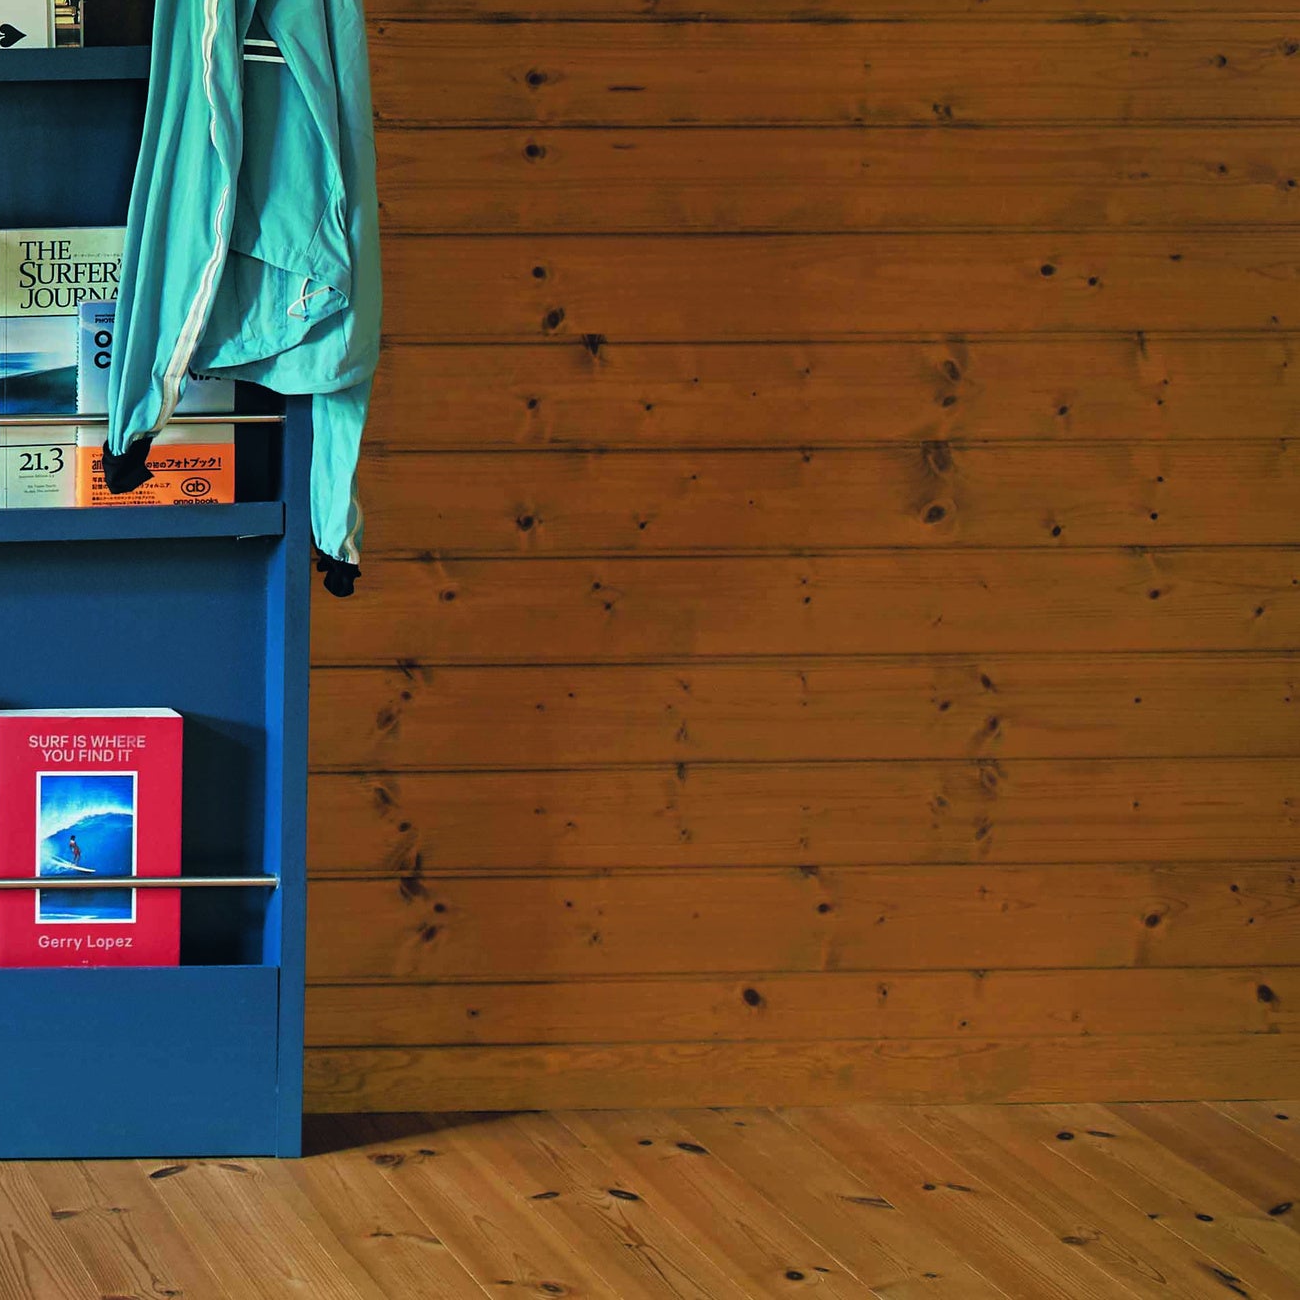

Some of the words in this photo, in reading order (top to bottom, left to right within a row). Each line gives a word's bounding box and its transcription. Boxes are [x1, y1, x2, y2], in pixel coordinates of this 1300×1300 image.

[19, 240, 71, 261] THE
[19, 258, 122, 288] SURFER'
[19, 447, 64, 474] 21.3
[186, 480, 205, 493] ab
[194, 497, 219, 505] books
[28, 735, 69, 748] SURF
[73, 735, 87, 748] IS
[90, 735, 146, 748] WHERE
[42, 749, 75, 762] YOU
[78, 749, 114, 762] FIND
[118, 749, 133, 762] IT
[38, 935, 82, 951] Gerry
[87, 935, 133, 950] Lopez
